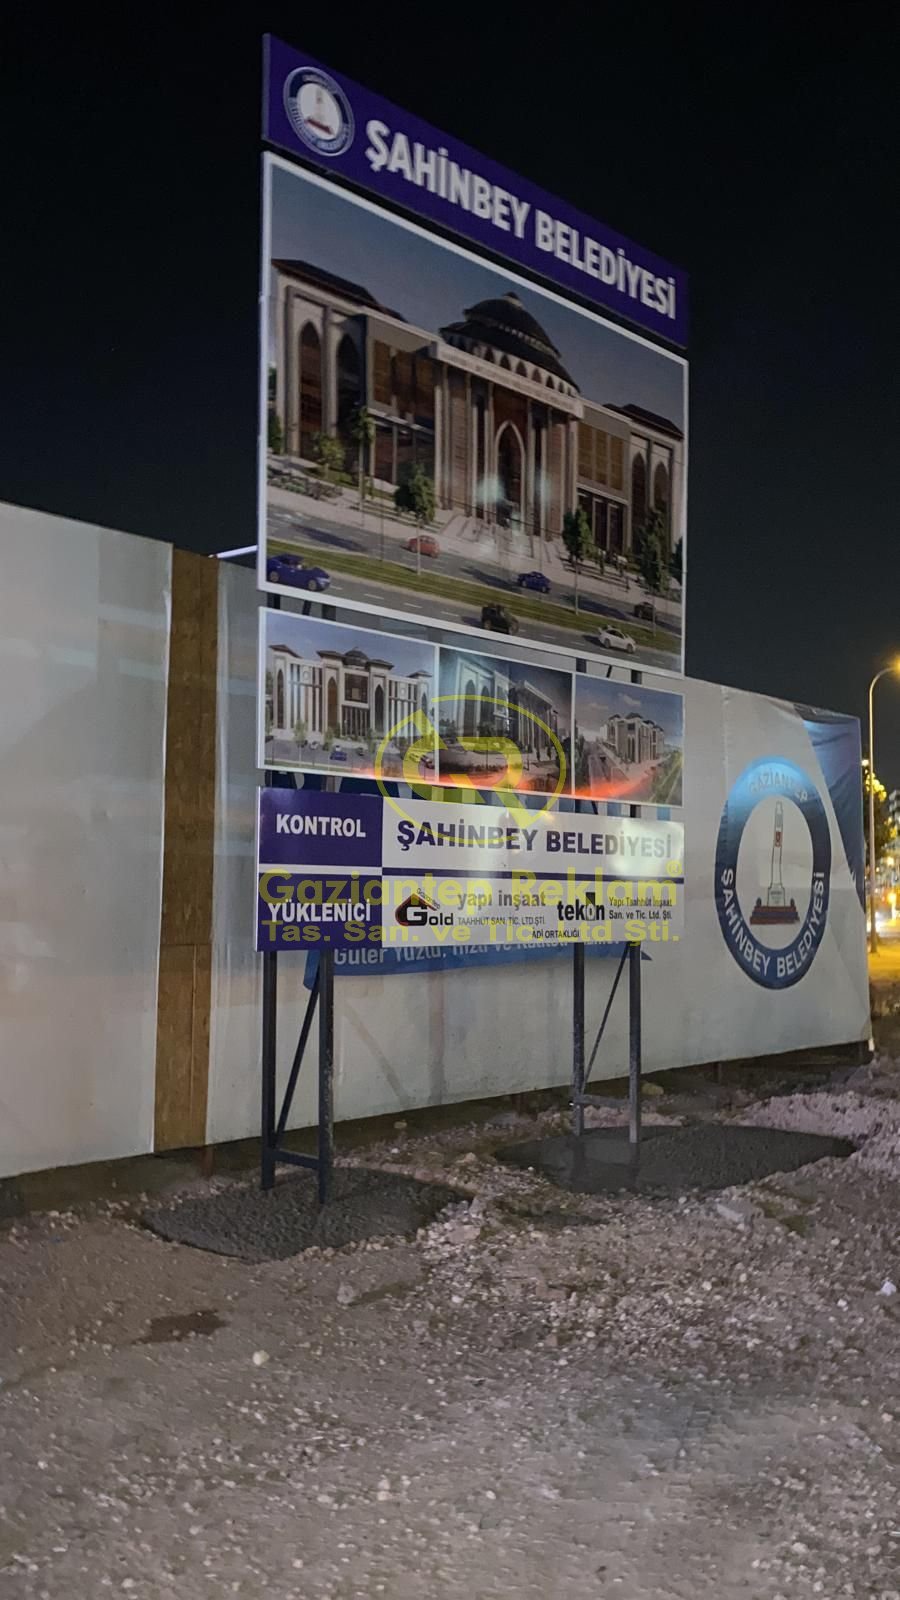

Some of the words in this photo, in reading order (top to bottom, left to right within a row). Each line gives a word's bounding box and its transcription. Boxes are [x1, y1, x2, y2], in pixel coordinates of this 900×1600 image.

[365, 118, 531, 239] ŞAHİNBEY
[535, 208, 677, 320] BELEDİYESİ
[276, 814, 367, 838] KONTROL
[397, 818, 538, 852] ŞAHİNBEY
[546, 830, 672, 859] BELEDİYESİ
[268, 898, 371, 923] YÜKLENİCİ
[402, 899, 454, 926] Gold
[498, 890, 546, 911] inşaat
[721, 868, 771, 978] ŞAHİNBEY
[776, 872, 825, 978] BELEDİYESİ
